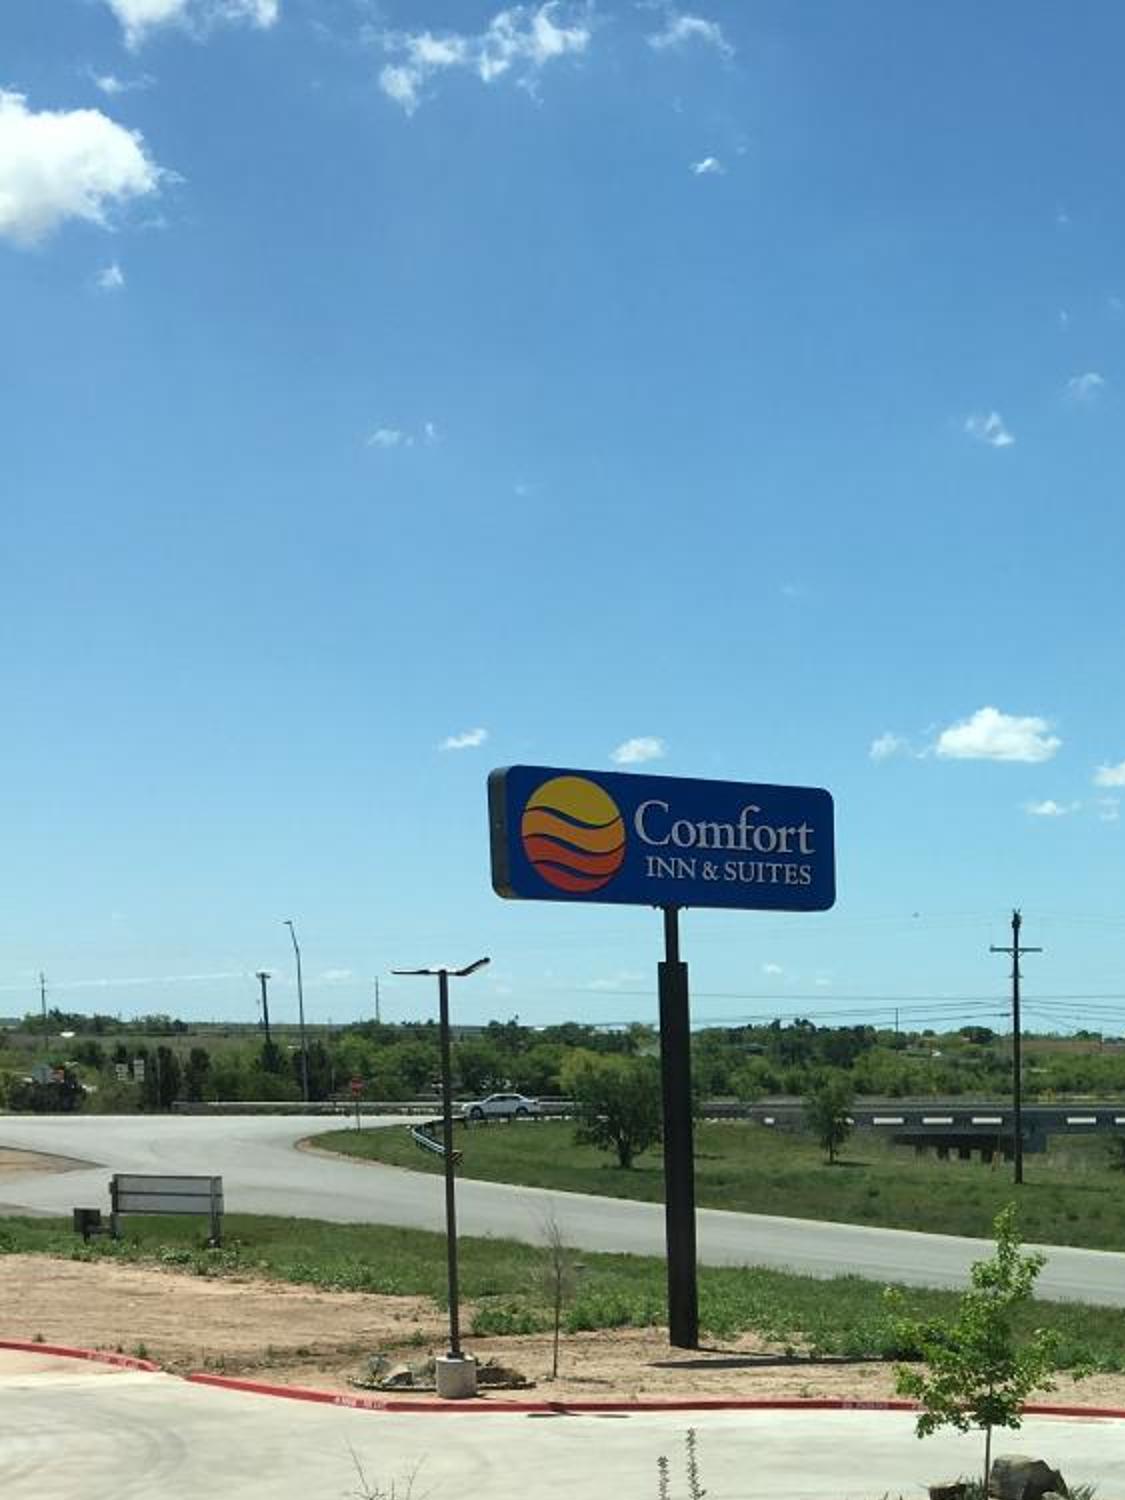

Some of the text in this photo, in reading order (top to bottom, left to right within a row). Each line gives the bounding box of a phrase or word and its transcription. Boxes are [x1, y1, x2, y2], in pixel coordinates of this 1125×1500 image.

[634, 800, 815, 854] Comfort
[645, 856, 811, 885] INN & SUITES
